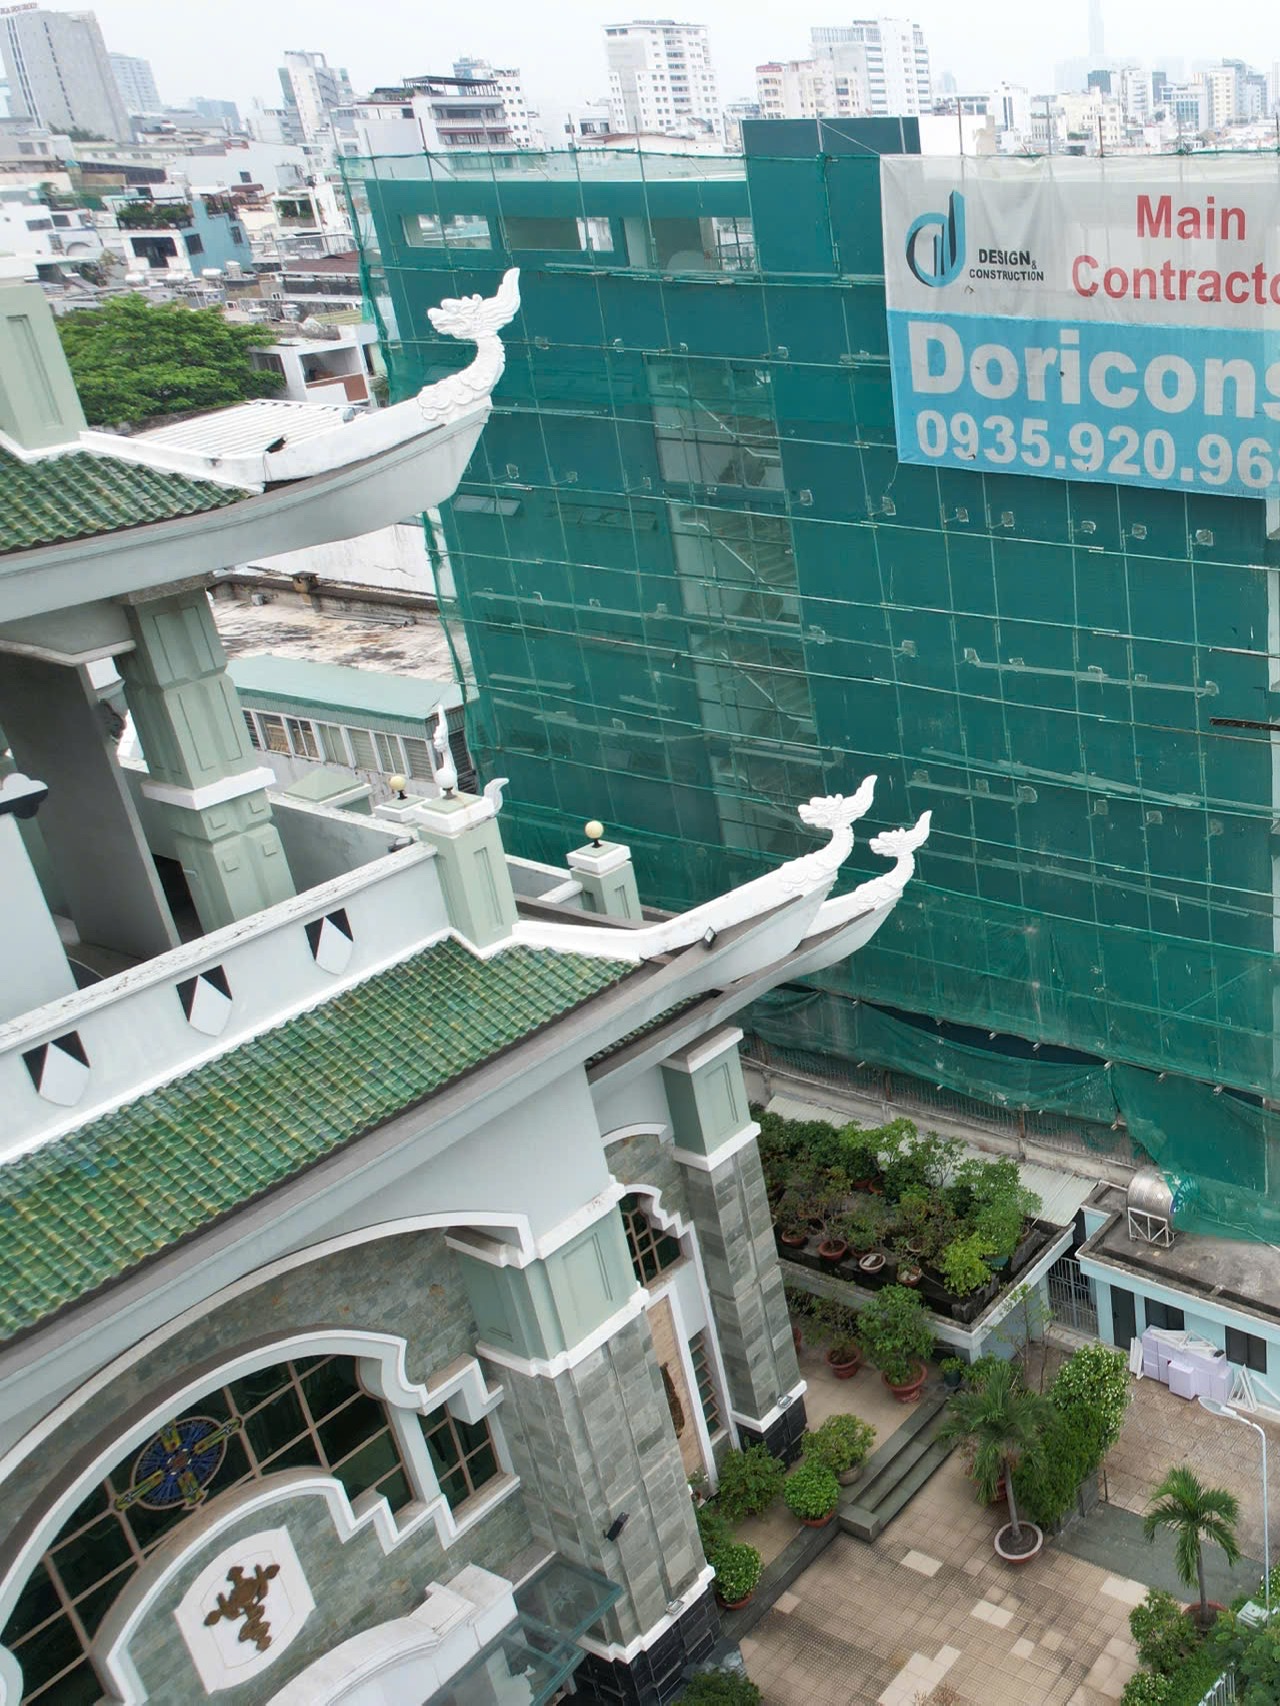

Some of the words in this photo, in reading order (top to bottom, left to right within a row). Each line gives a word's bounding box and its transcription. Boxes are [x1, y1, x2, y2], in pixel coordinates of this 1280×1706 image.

[1136, 194, 1246, 241] Main
[979, 248, 1031, 266] DESIGN
[969, 269, 1045, 281] CONSTRUCTION
